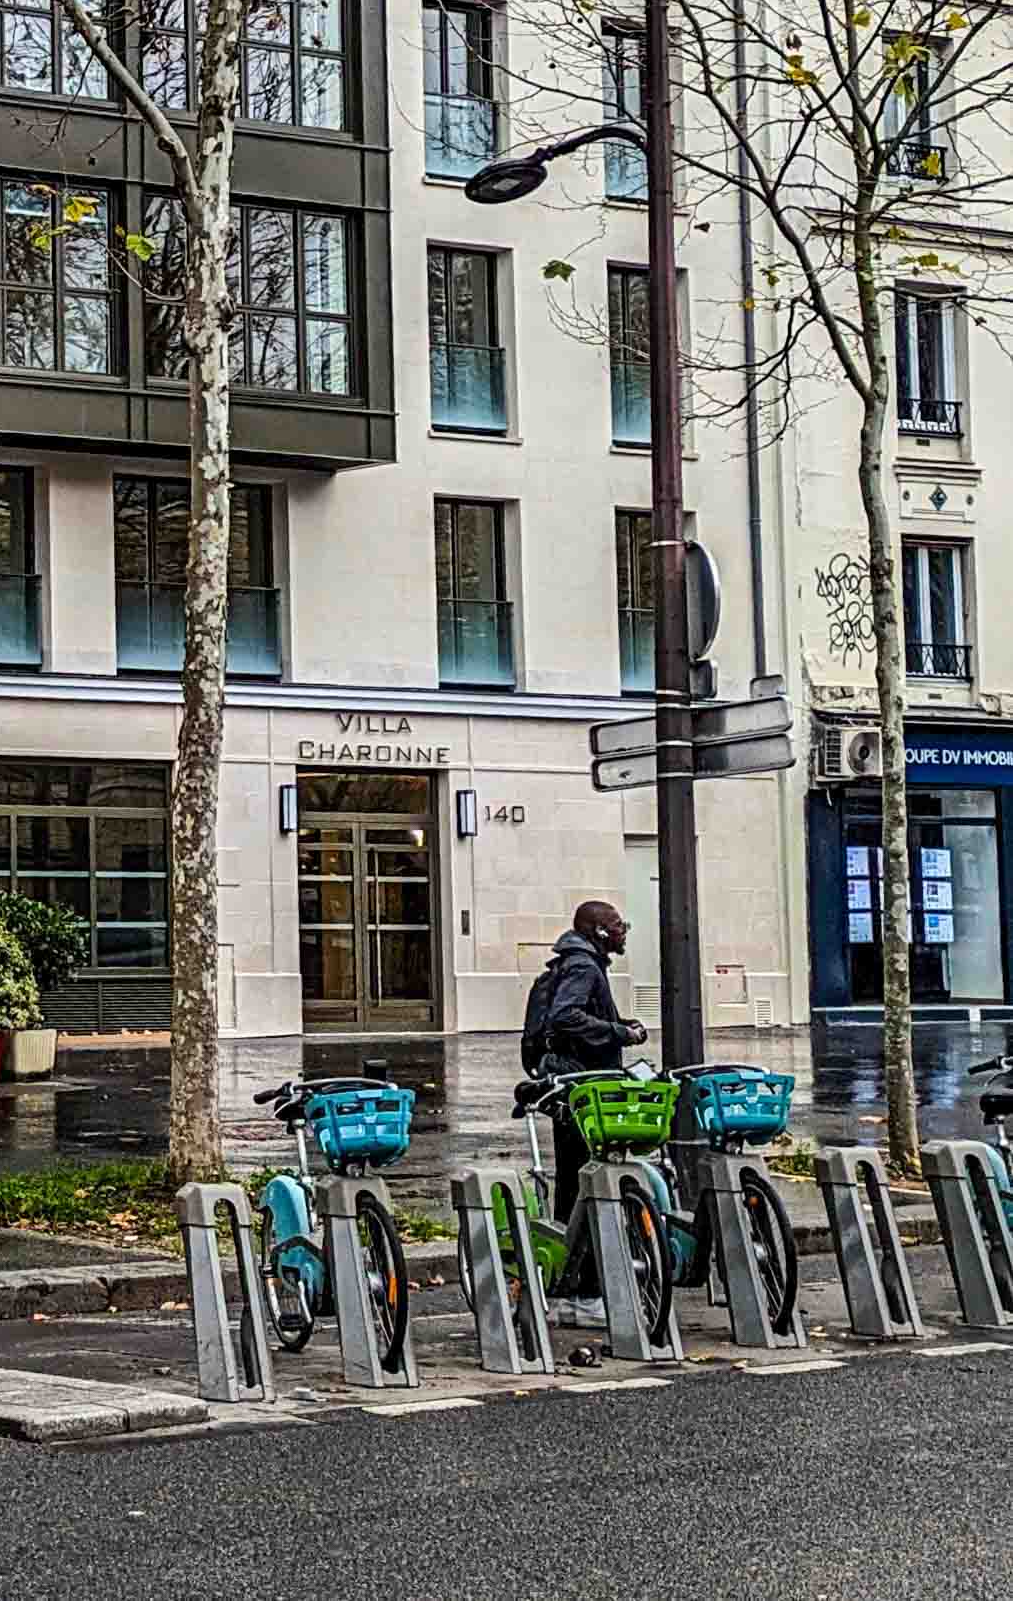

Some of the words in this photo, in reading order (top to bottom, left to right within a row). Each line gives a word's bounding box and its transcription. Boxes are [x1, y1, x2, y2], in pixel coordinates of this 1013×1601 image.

[337, 714, 413, 734] VILLA
[298, 741, 451, 764] CHARONNE
[905, 748, 940, 765] OUPE
[942, 749, 961, 765] DV
[486, 805, 525, 824] 140
